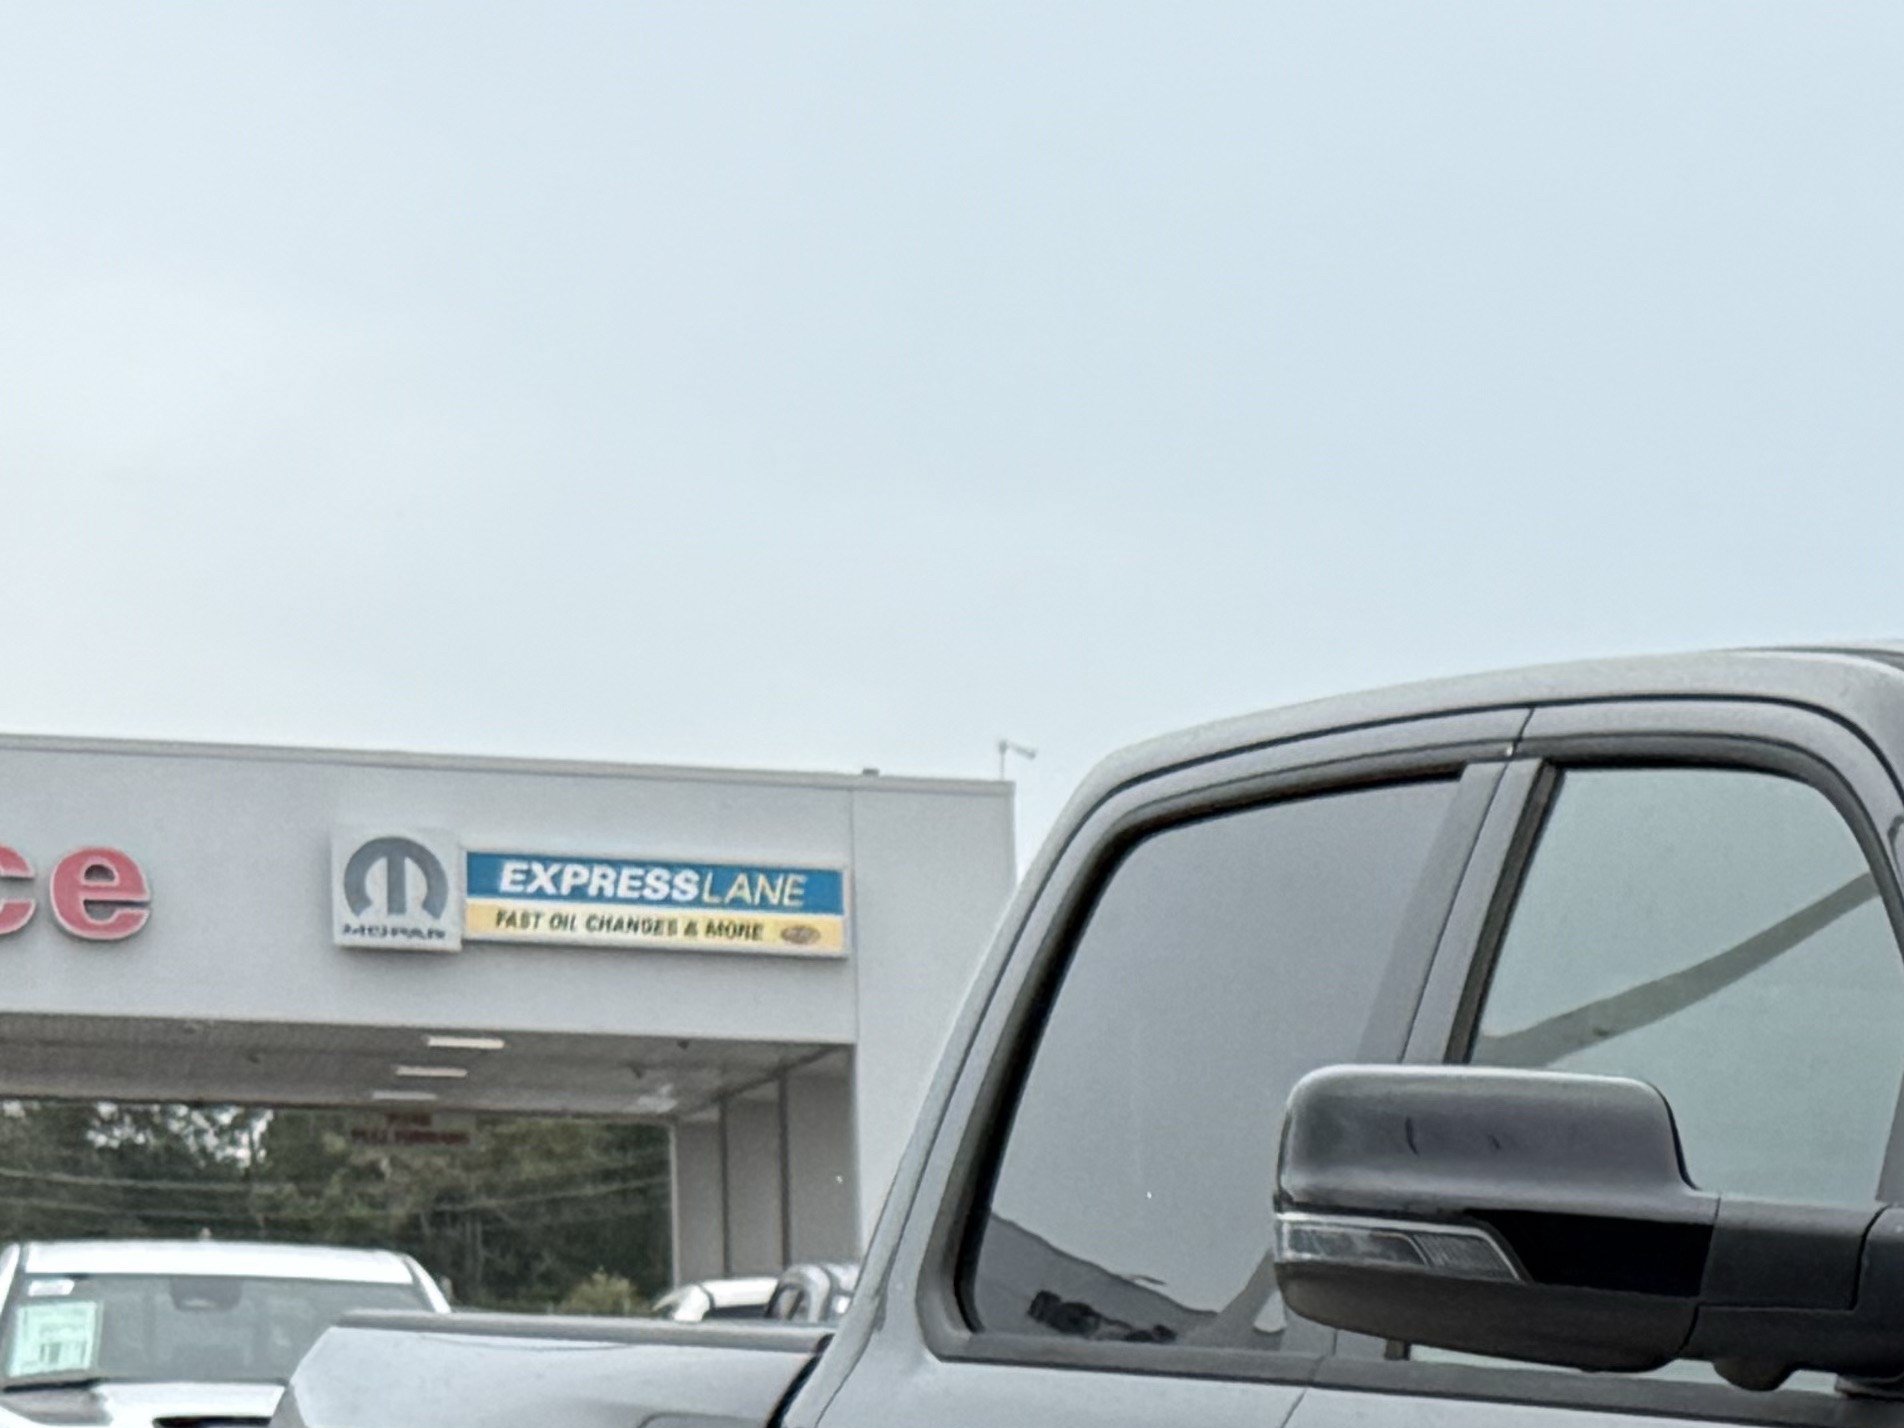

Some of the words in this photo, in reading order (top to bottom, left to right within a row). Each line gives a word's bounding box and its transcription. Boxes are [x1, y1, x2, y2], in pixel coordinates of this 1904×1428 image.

[496, 909, 543, 930] FAST
[550, 913, 578, 932] OIL
[586, 914, 678, 937] CHANGES
[705, 919, 765, 941] MORE
